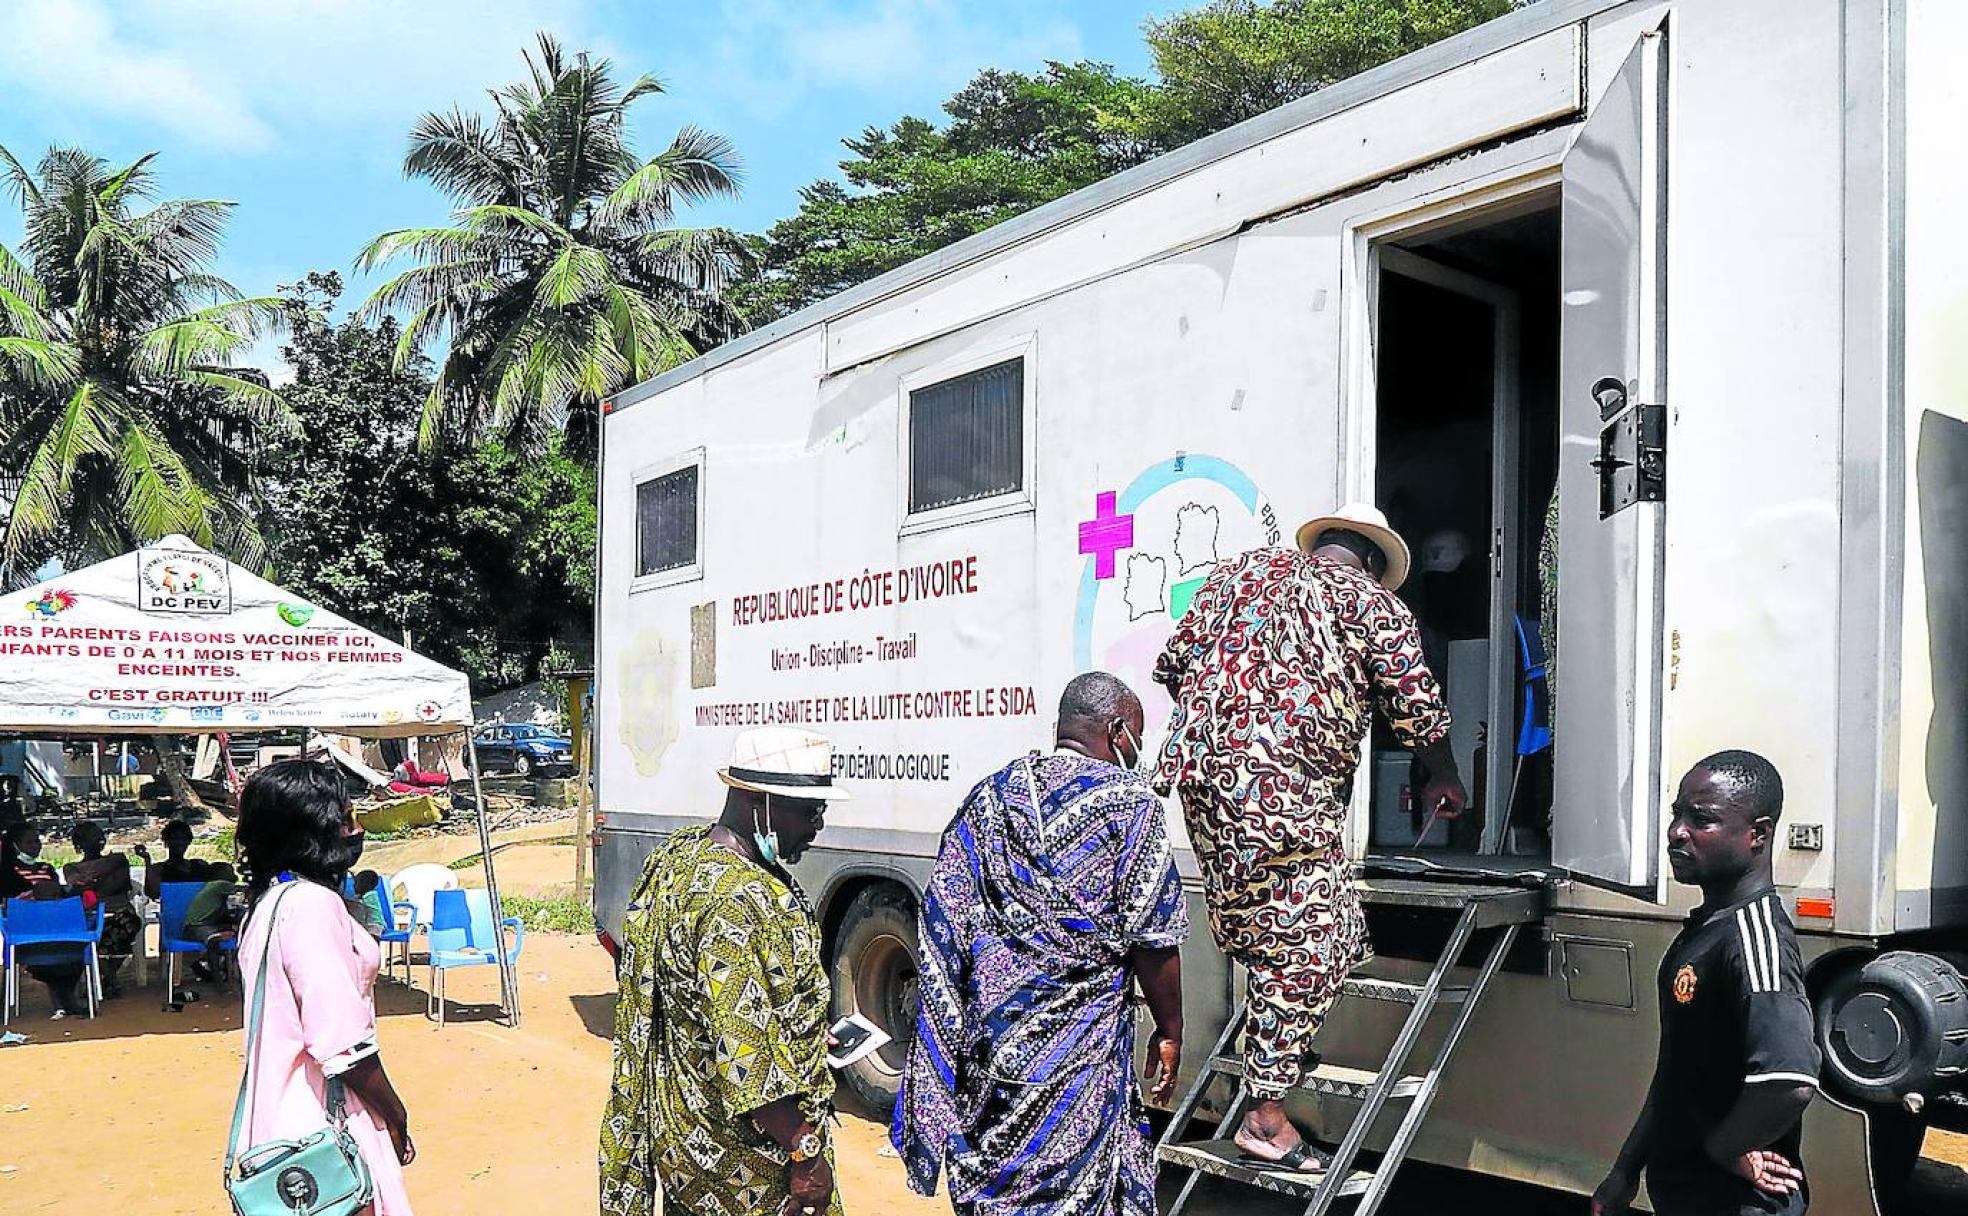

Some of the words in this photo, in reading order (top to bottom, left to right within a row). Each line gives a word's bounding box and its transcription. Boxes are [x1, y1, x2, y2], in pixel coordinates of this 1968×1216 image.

[1261, 503, 1280, 546] Sida
[151, 596, 177, 608] DC
[184, 597, 222, 609] PEV
[732, 584, 819, 626] REPUBLIQUE
[824, 580, 844, 614] DE
[849, 568, 892, 610] CÔTE
[898, 556, 978, 603] D'IVOIRE
[0, 625, 33, 638] RS
[41, 626, 141, 641] PARENTS
[149, 630, 236, 644] FAISONS
[242, 633, 338, 647] VACCINER
[345, 635, 375, 649] ICI,
[88, 645, 116, 658] DE
[123, 646, 135, 658] 0
[142, 648, 156, 659] A
[164, 648, 185, 660] 11
[194, 649, 245, 661] MOIS
[251, 650, 275, 661] ET
[281, 651, 321, 662] NOS
[327, 652, 402, 663] FEMMES
[771, 647, 800, 671] Union
[810, 640, 863, 672] Discipline
[876, 632, 916, 661] Travail
[118, 663, 241, 677] ENCEINTES.
[88, 688, 150, 702] C'EST
[156, 690, 246, 703] GRATUIT
[695, 703, 743, 727] MINISTERE
[746, 702, 759, 725] DE
[761, 702, 775, 725] LA
[777, 699, 812, 724] SANTE
[815, 698, 829, 723] ET
[833, 696, 849, 721] DE
[852, 695, 869, 721] LA
[872, 693, 912, 720] LUTTE
[914, 690, 972, 719] CONTRE
[976, 688, 995, 717] LE
[999, 686, 1037, 716] SIDA
[107, 708, 145, 721] Gavi
[830, 745, 949, 782] ÉPIDÉMIOLOGIQUE
